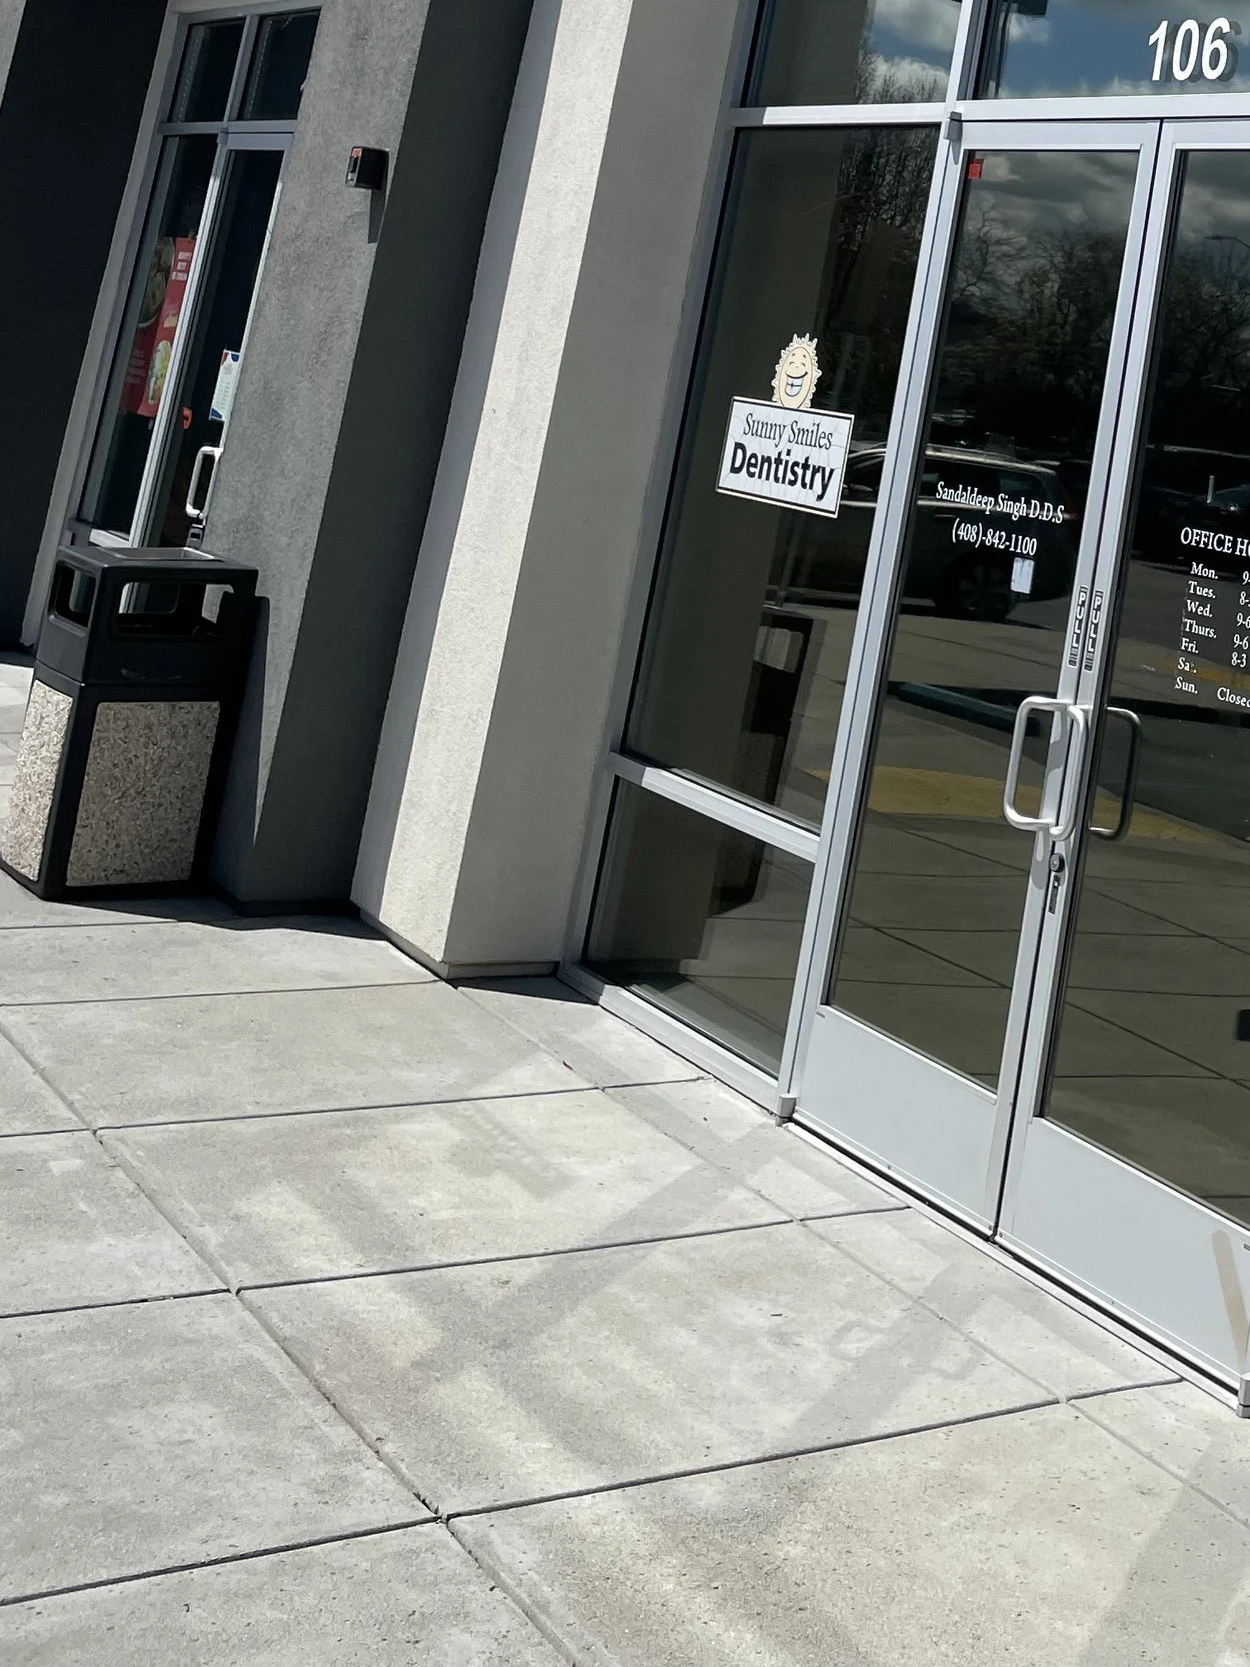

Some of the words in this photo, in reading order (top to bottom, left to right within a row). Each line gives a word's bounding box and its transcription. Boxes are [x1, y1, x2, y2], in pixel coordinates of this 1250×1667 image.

[1148, 17, 1231, 81] 106
[743, 412, 787, 448] Sunny
[788, 419, 833, 450] Smiles
[729, 441, 835, 502] Dentistry
[935, 481, 995, 514] Sandaldeep
[996, 493, 1027, 521] Singh
[1028, 499, 1065, 524] D.D.S
[952, 517, 1037, 556] (408)-842-1100
[1180, 527, 1233, 553] OFFICE
[1190, 561, 1218, 580] Mon.
[1188, 580, 1216, 598] Tues.
[1072, 592, 1086, 648] PULL
[1087, 596, 1102, 653] PULL
[1186, 599, 1213, 617] Wed.
[1184, 618, 1217, 639] Thurs.
[1233, 634, 1249, 650] 9-6
[1180, 637, 1199, 654] Fri.
[1231, 651, 1247, 668] 8-3
[1175, 676, 1198, 694] Sun.
